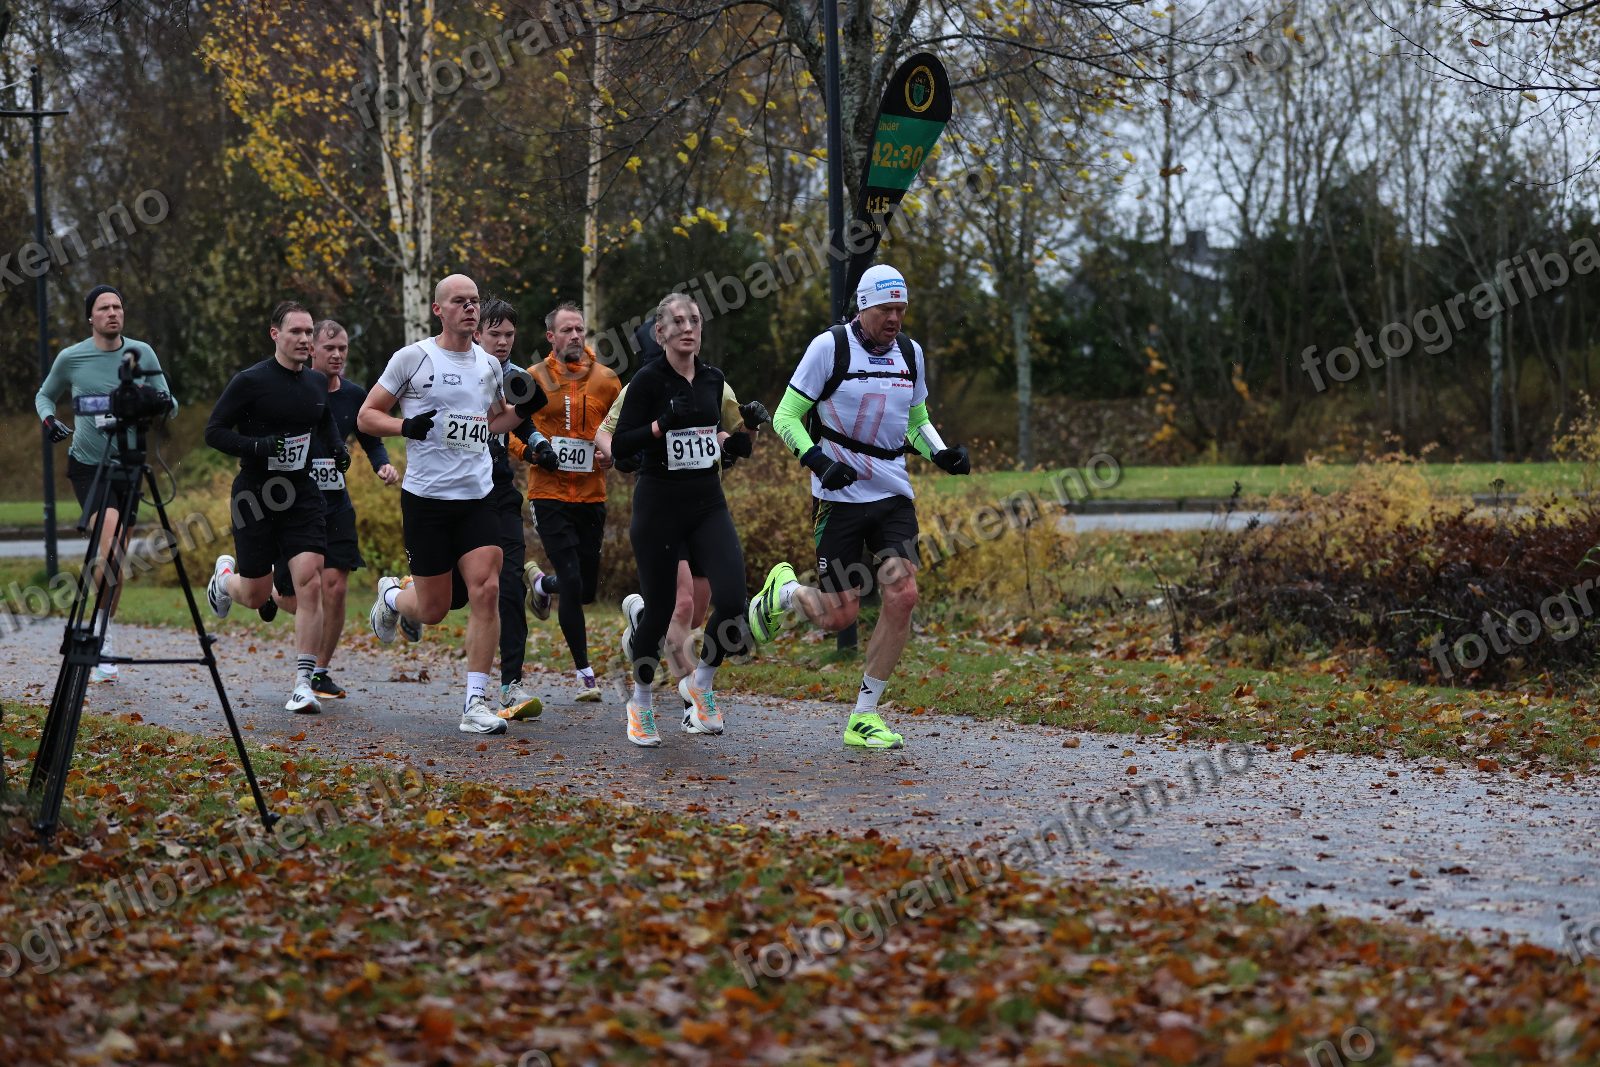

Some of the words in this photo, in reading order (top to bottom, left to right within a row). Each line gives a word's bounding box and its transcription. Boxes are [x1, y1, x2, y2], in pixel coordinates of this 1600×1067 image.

[872, 141, 923, 169] 42:30
[446, 421, 487, 443] 2140
[277, 445, 304, 463] 357
[559, 447, 586, 465] 640
[673, 437, 716, 460] 9118
[311, 468, 339, 482] 393
